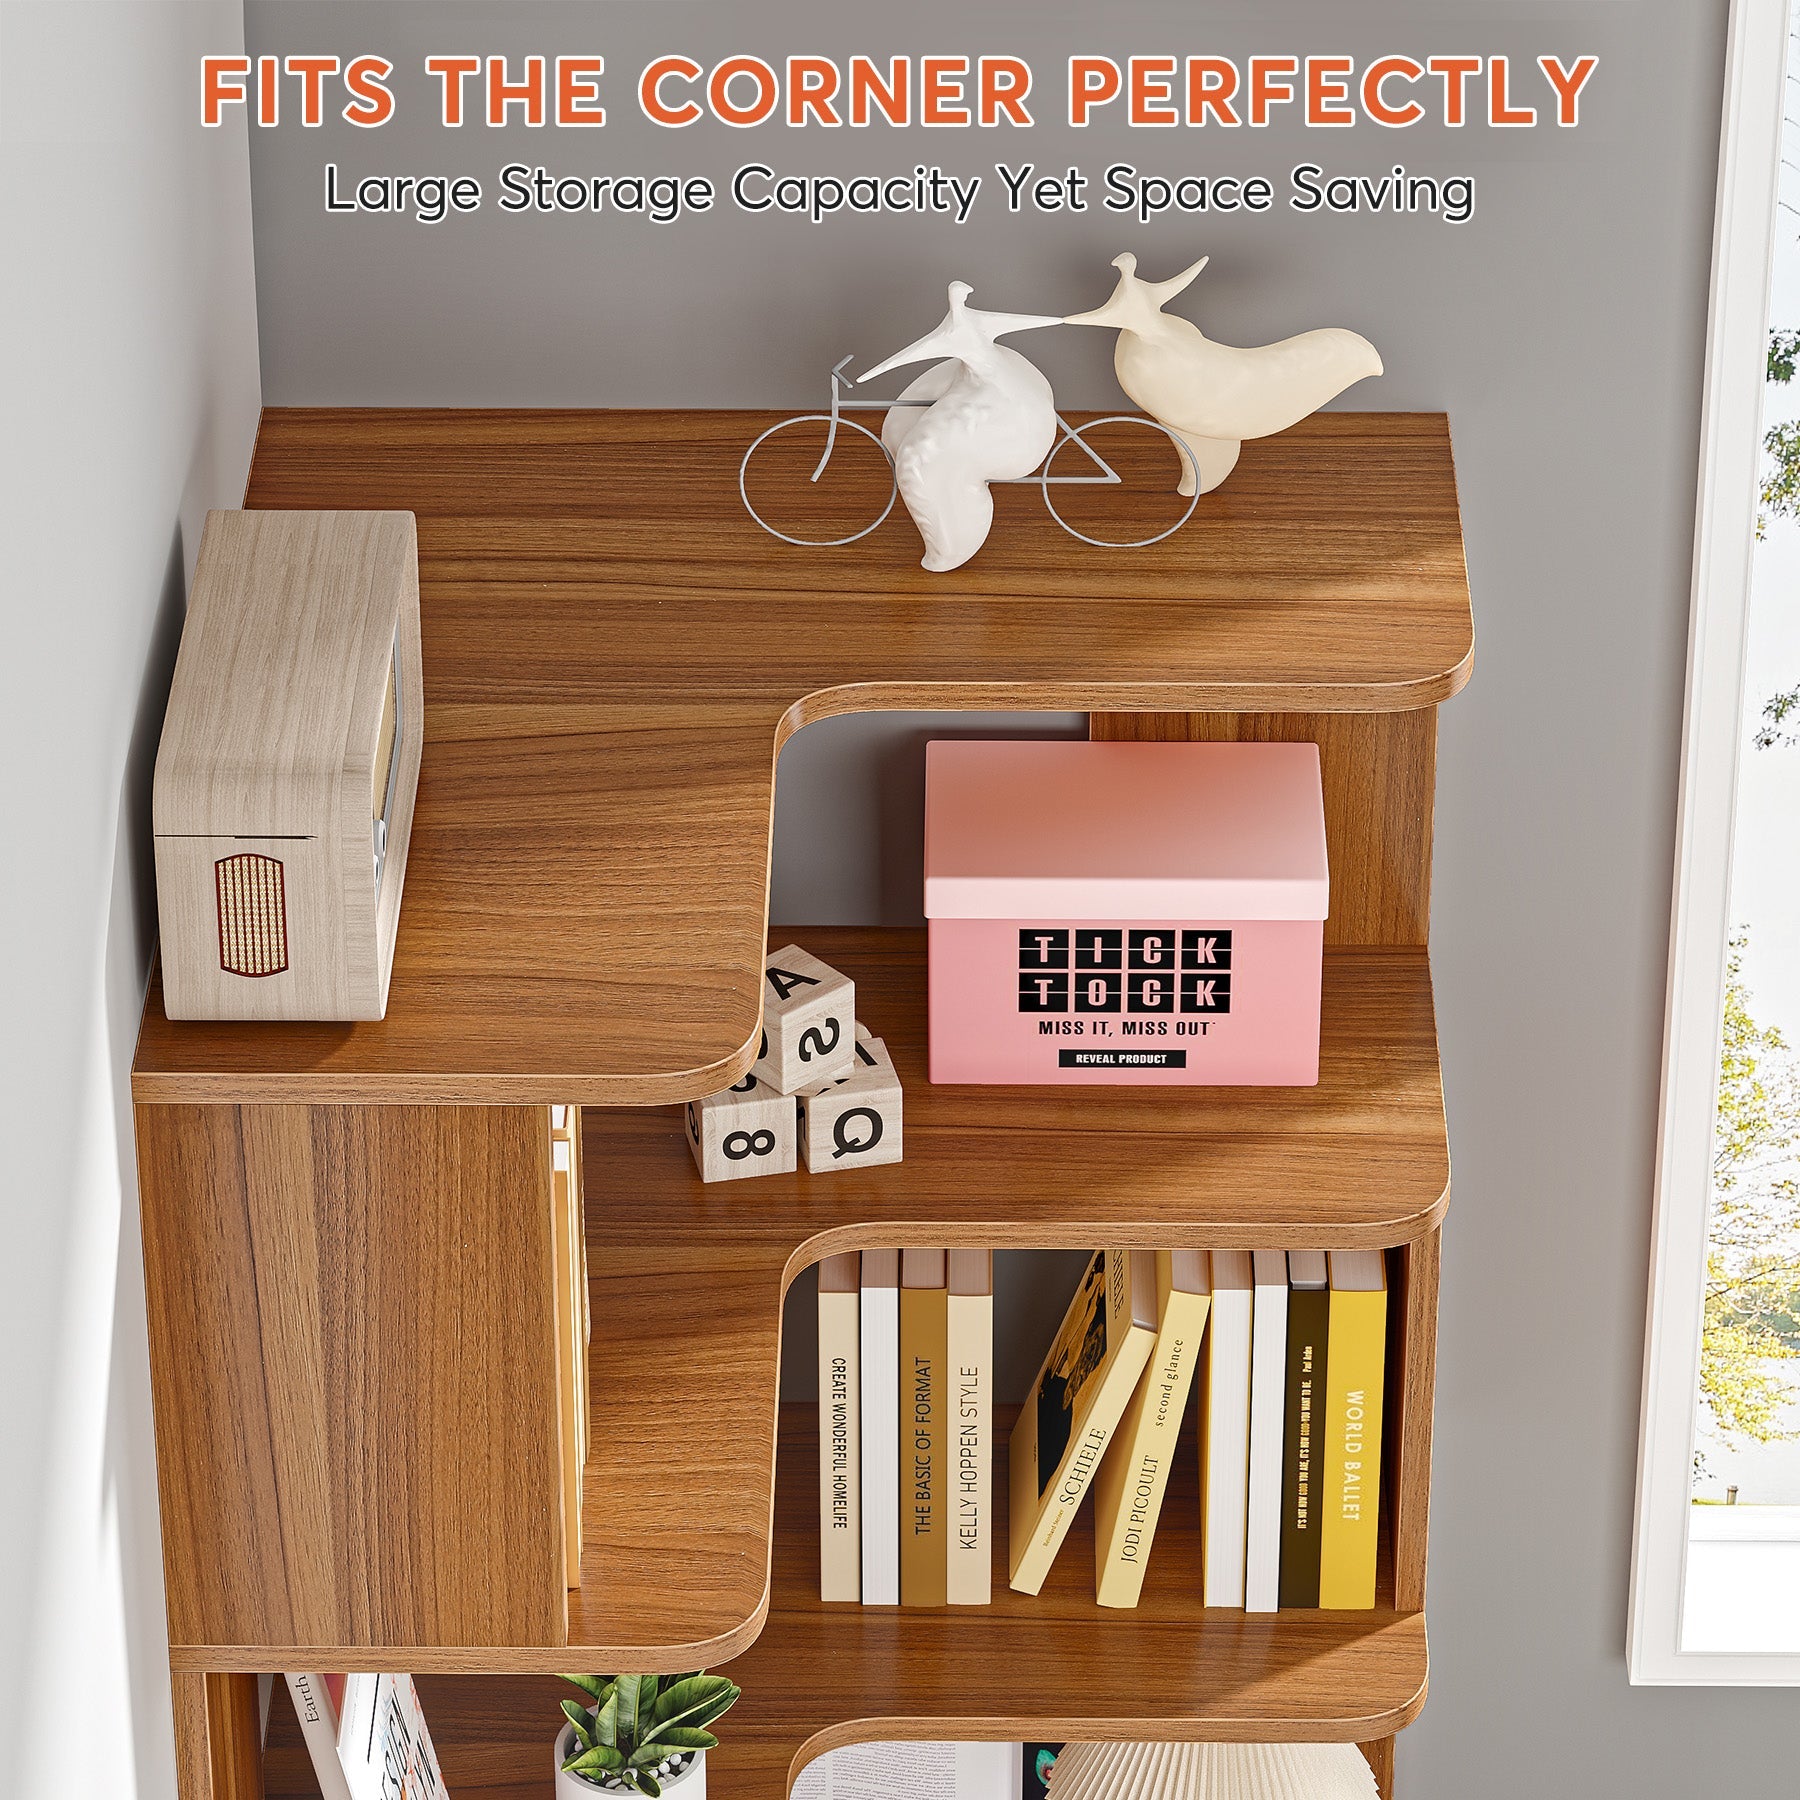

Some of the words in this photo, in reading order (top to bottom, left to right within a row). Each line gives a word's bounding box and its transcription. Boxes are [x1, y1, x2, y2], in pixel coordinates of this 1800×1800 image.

[1031, 934, 1220, 966] TICK
[766, 967, 822, 1001] A
[1031, 976, 1219, 1008] TOCK
[1038, 1020, 1084, 1035] MISS
[1092, 1020, 1114, 1038] IT,
[1122, 1020, 1168, 1036] MISS
[1075, 1053, 1116, 1064] REVEAL
[1118, 1053, 1168, 1065] PRODUCT
[722, 1128, 776, 1161] 8
[831, 1106, 884, 1160] Q
[831, 1357, 847, 1400] CREATE
[914, 1356, 932, 1424] FORMAT
[960, 1367, 979, 1418] STYLE
[1155, 1384, 1173, 1428] second
[1164, 1339, 1184, 1382] glance
[832, 1402, 848, 1472] WONDERFUL
[914, 1428, 932, 1451] OF
[1344, 1389, 1365, 1454] WORLD
[914, 1455, 932, 1501] BASIC
[959, 1425, 978, 1493] HOPPEN
[1059, 1427, 1108, 1506] SCHIELE
[832, 1475, 848, 1529] HOMELIFE
[1130, 1454, 1160, 1525] PICOULT
[1341, 1460, 1363, 1521] BALLET
[914, 1505, 932, 1536] THE
[959, 1498, 977, 1550] KELLY
[1120, 1528, 1142, 1564] JODI
[294, 1674, 321, 1724] Earth
